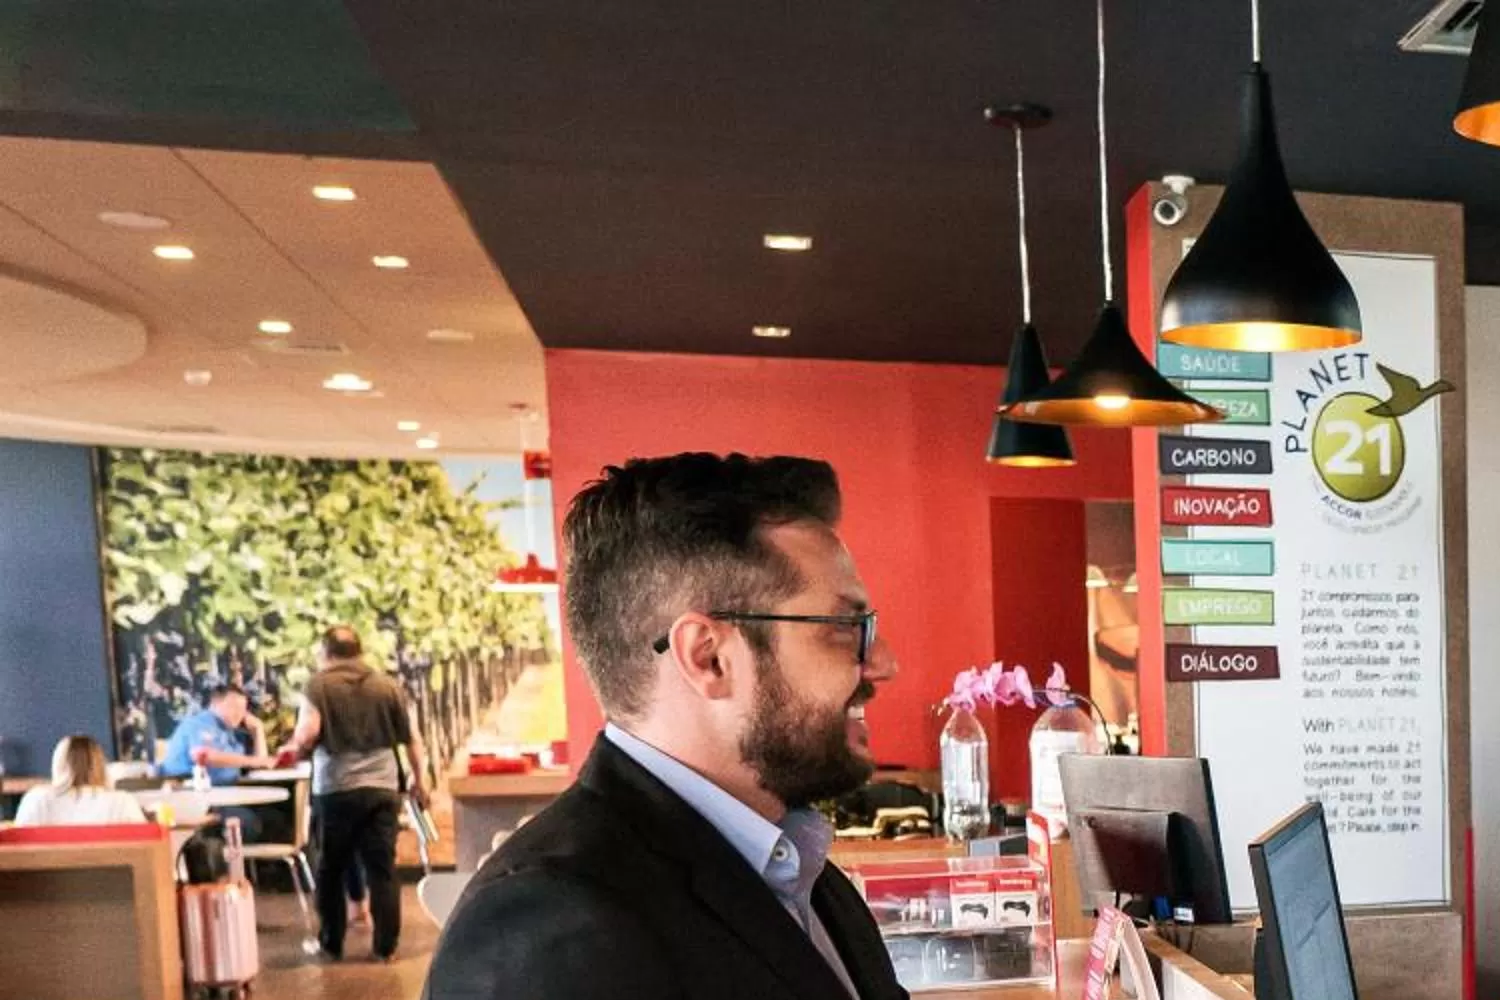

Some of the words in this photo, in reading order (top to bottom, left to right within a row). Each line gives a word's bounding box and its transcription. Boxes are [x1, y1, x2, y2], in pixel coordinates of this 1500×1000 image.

[1180, 352, 1241, 372] SAÚDE
[1281, 353, 1370, 453] PLANET
[1171, 448, 1257, 467] CARBONO
[1324, 420, 1392, 476] 21
[1174, 493, 1261, 519] INOVAÇÃO
[1300, 561, 1377, 580] PLANET
[1396, 562, 1419, 580] 21
[1181, 651, 1258, 673] DIÁLOGO
[1302, 716, 1335, 733] With
[1303, 742, 1323, 755] We
[1366, 742, 1400, 754] made
